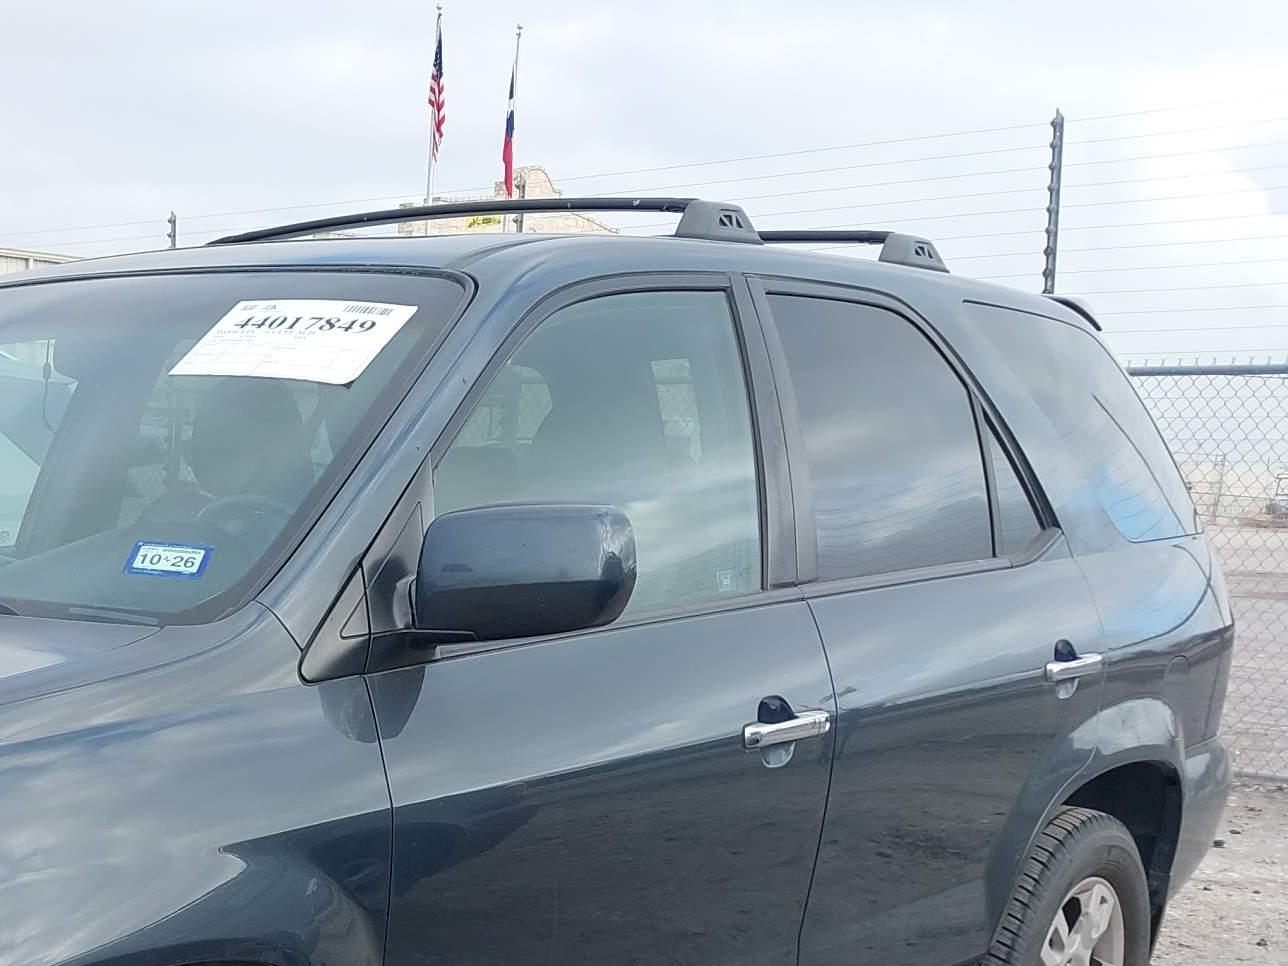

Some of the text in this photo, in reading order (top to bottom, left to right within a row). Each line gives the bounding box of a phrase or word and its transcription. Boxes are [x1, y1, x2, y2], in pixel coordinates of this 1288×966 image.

[233, 314, 377, 335] 44017849
[139, 553, 198, 569] 10 26
